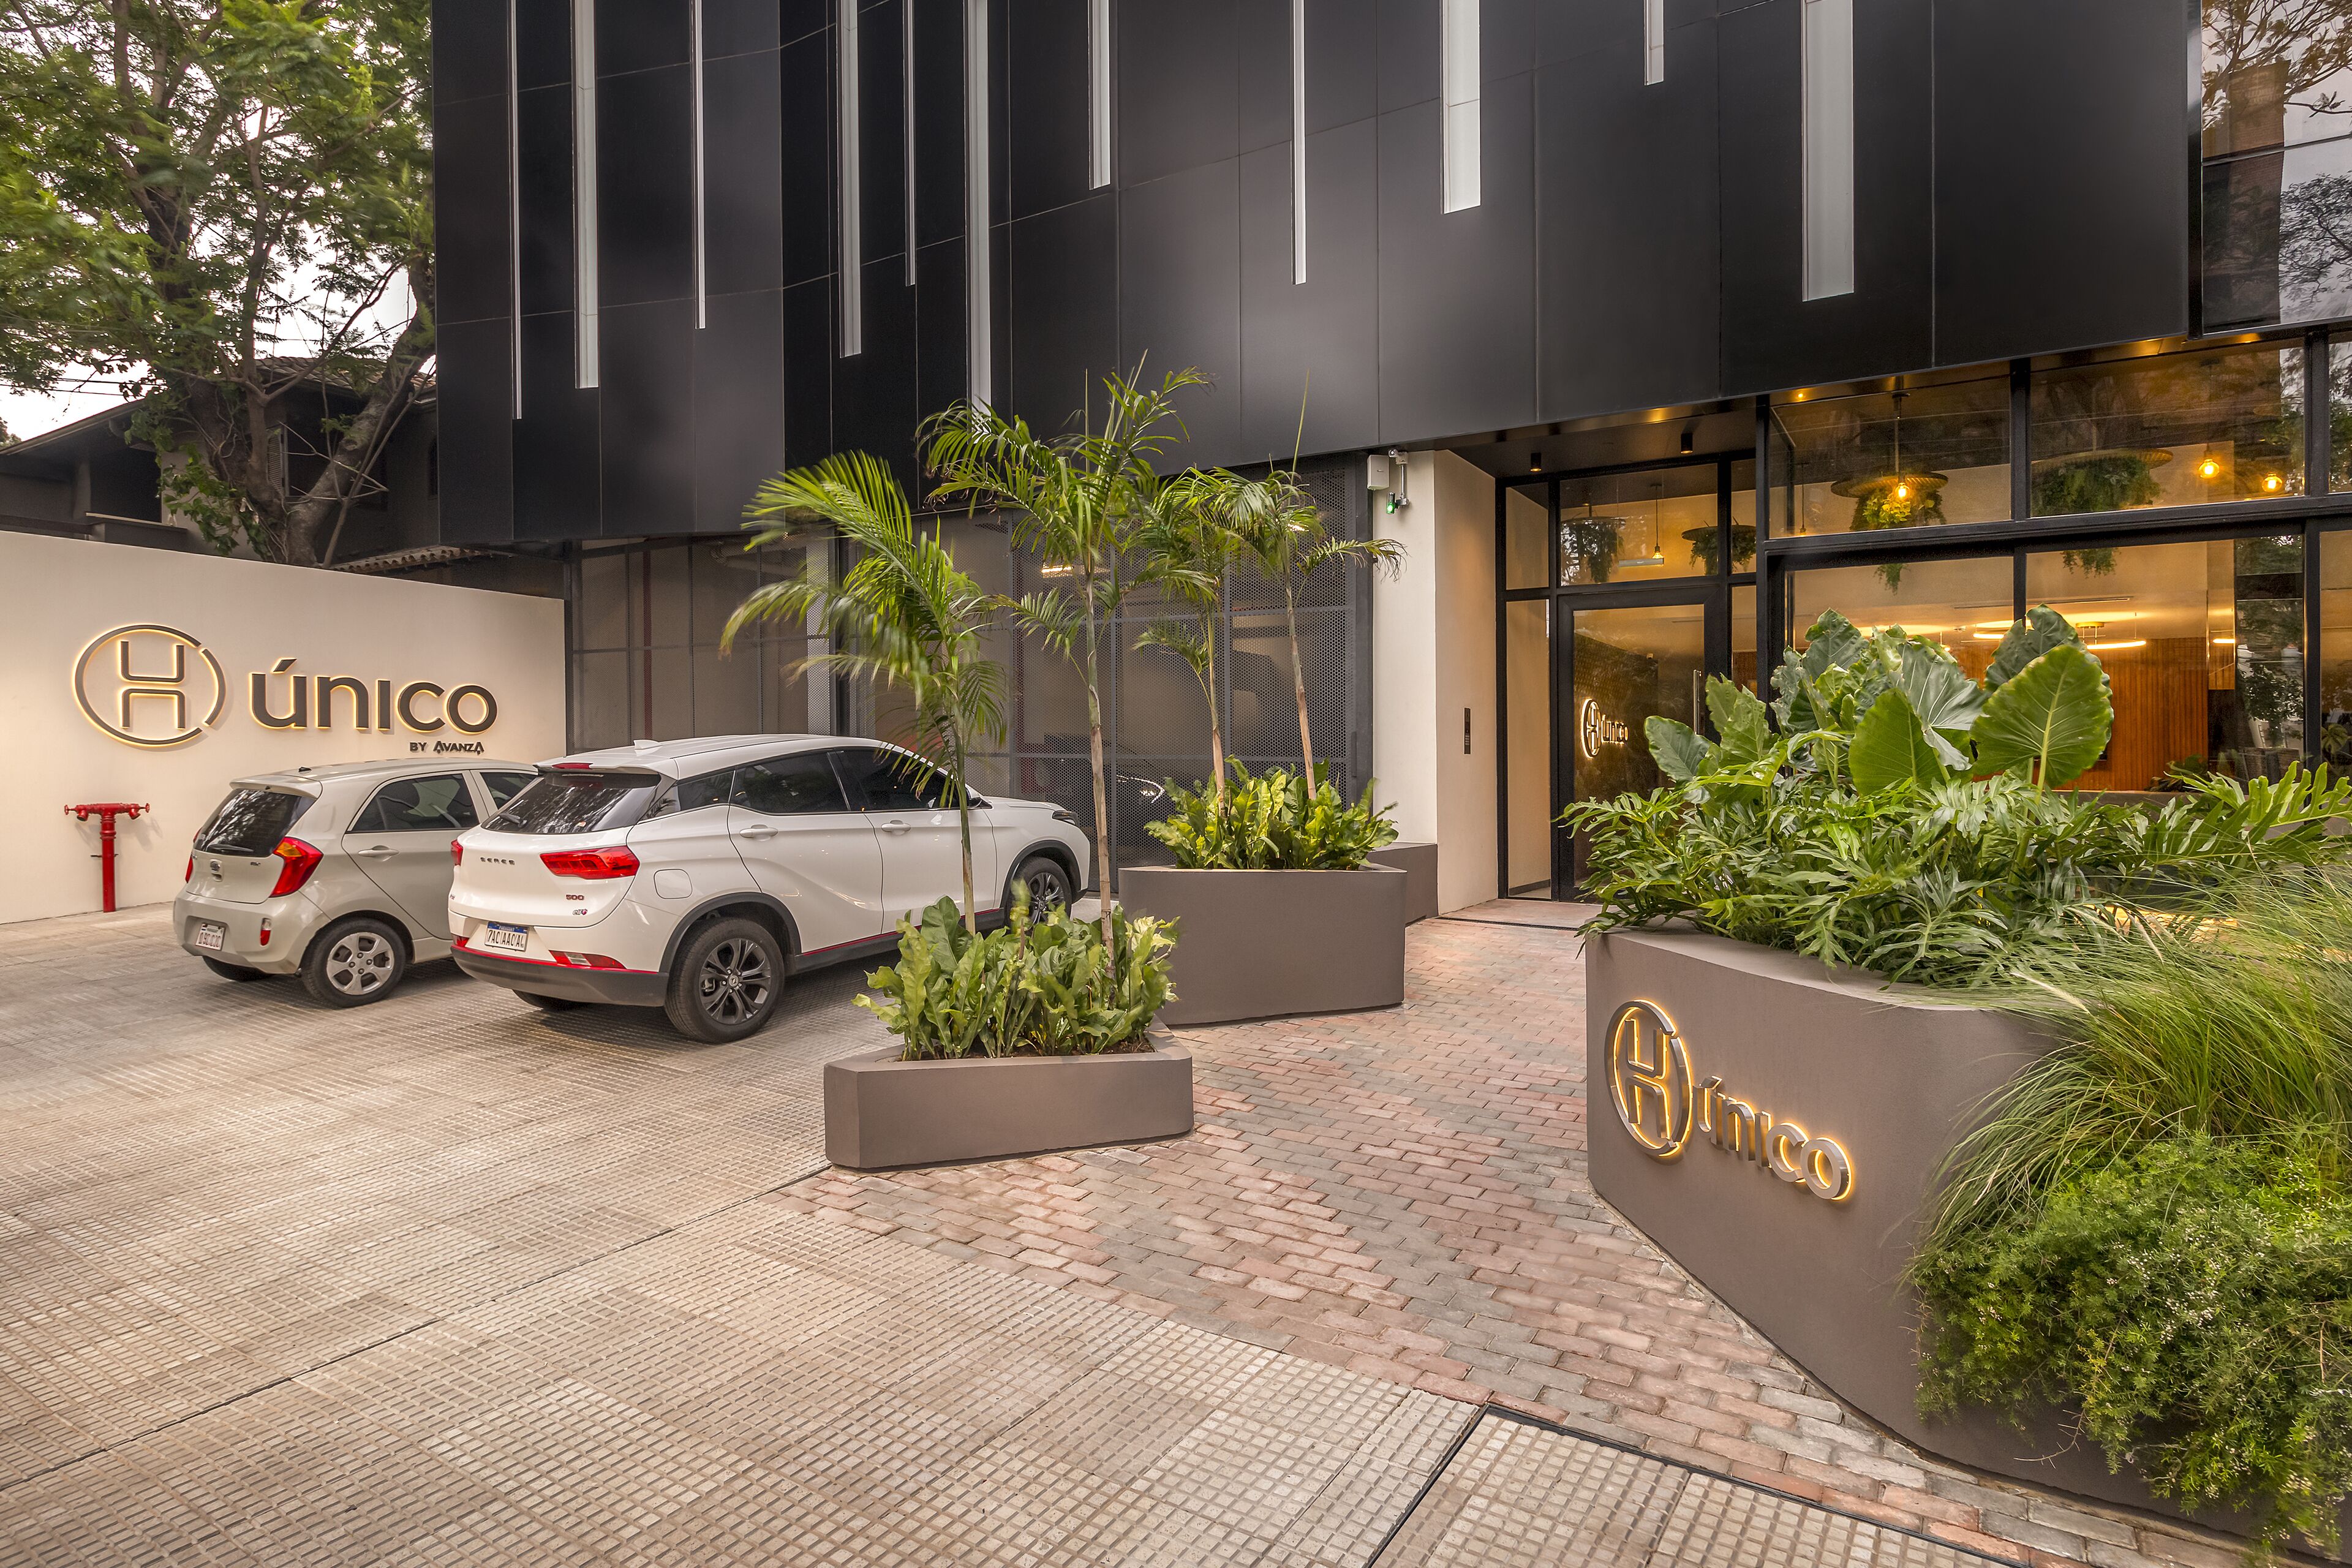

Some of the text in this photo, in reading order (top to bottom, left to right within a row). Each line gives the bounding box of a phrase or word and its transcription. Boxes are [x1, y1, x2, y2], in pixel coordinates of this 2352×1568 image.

[250, 657, 498, 733] único
[409, 741, 485, 755] BY AVANZA
[1692, 1076, 1853, 1200] único
